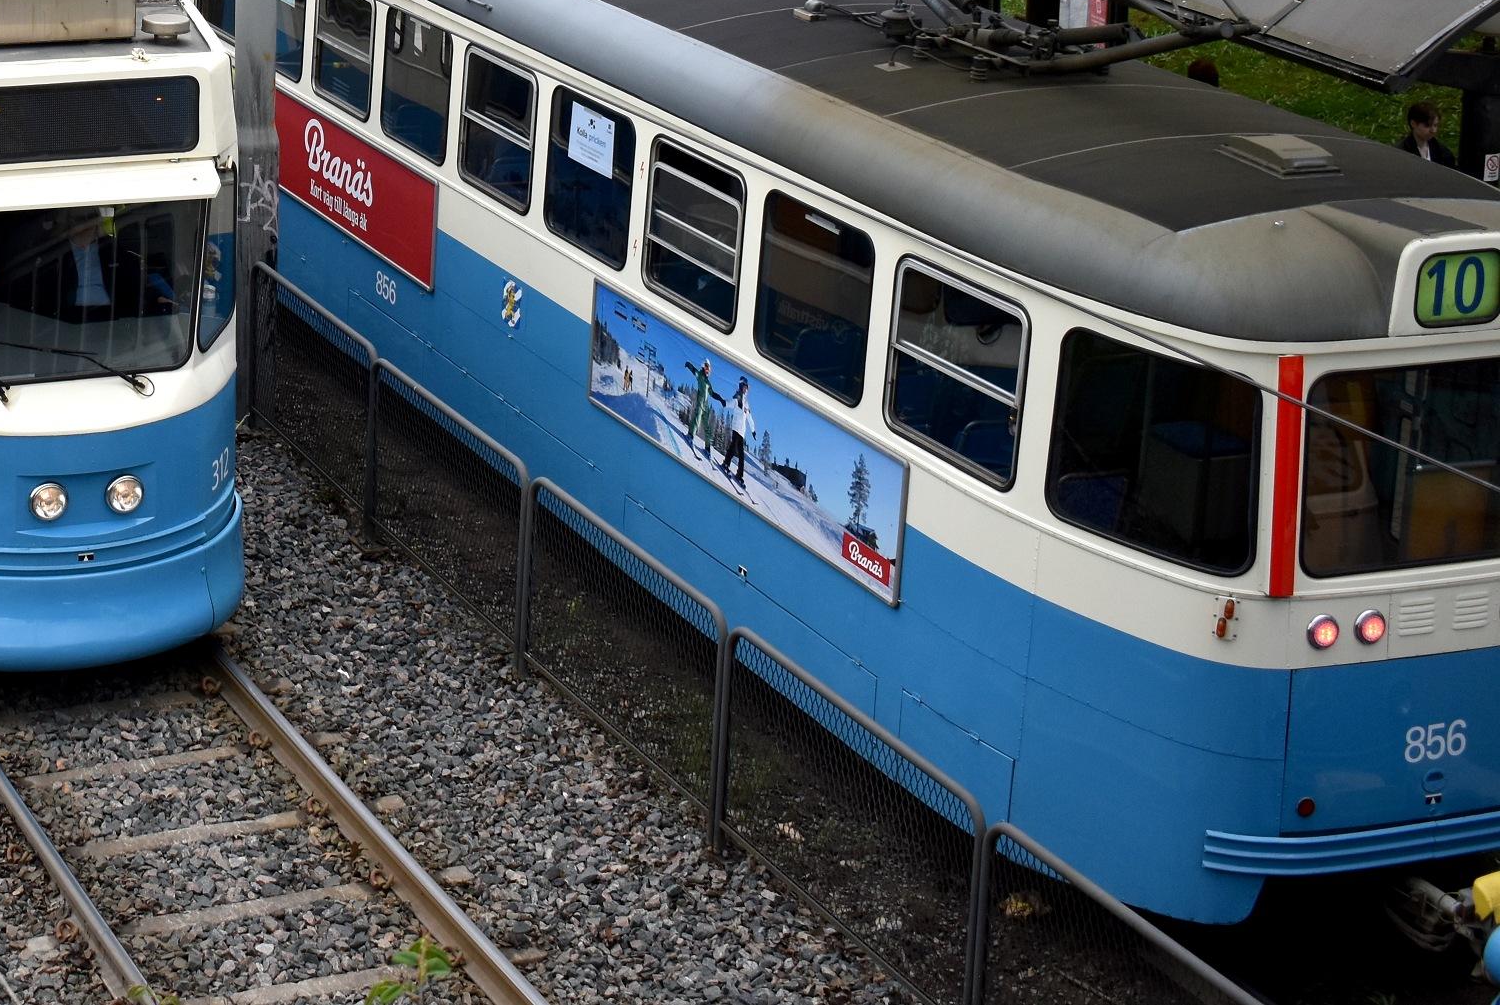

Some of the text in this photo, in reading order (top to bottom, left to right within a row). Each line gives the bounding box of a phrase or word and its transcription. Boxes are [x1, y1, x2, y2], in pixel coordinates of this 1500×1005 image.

[304, 118, 374, 207] Branäs
[310, 178, 367, 232] Kort väg till långa åk
[375, 270, 397, 305] 856
[1427, 256, 1485, 317] 10
[211, 446, 229, 491] 312
[848, 541, 883, 579] Branäs
[1404, 719, 1467, 763] 856
